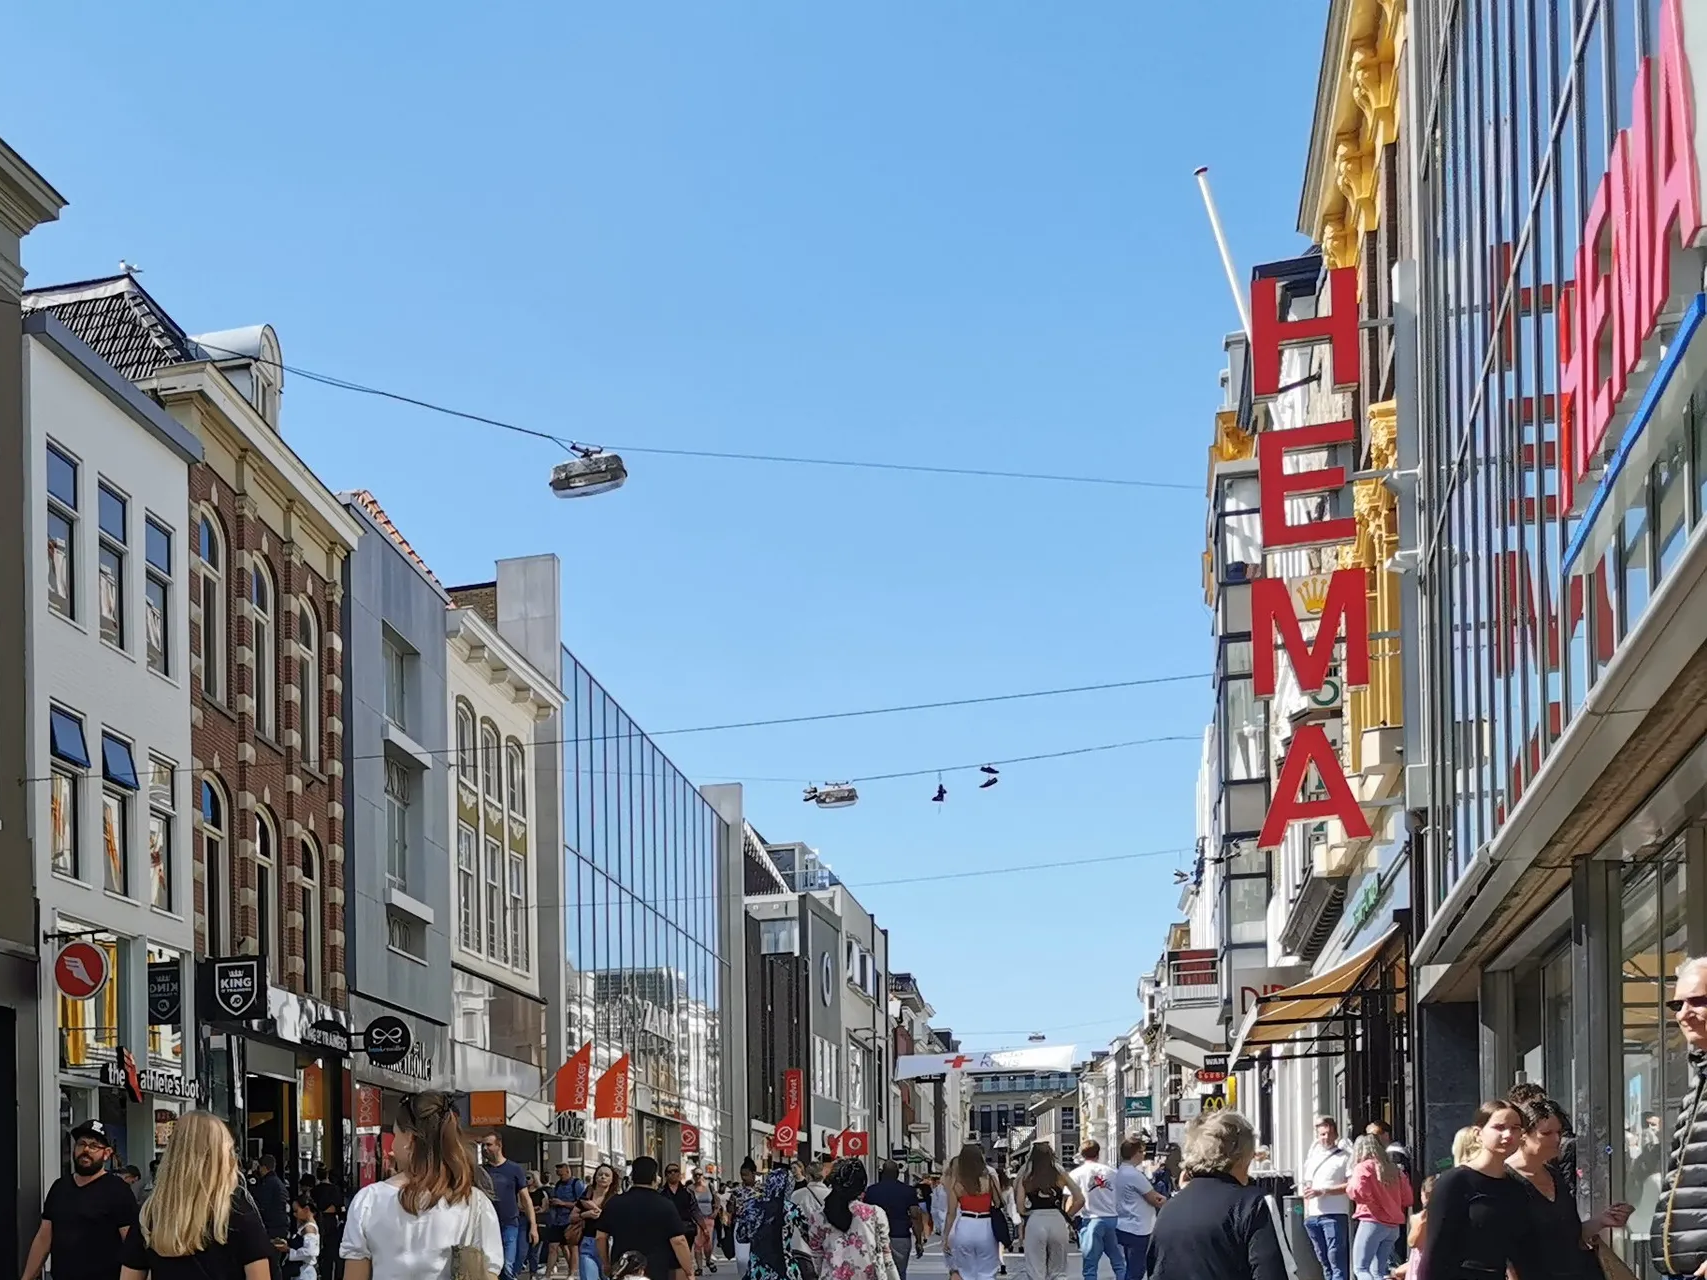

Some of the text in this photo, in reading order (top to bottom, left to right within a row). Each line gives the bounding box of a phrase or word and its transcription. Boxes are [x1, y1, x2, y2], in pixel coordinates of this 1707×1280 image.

[1559, 0, 1702, 518] HEMA
[1251, 266, 1372, 850] HEMA
[220, 977, 252, 989] KING
[108, 1063, 126, 1085] the
[575, 1062, 586, 1105] blokker
[613, 1072, 625, 1113] blokker
